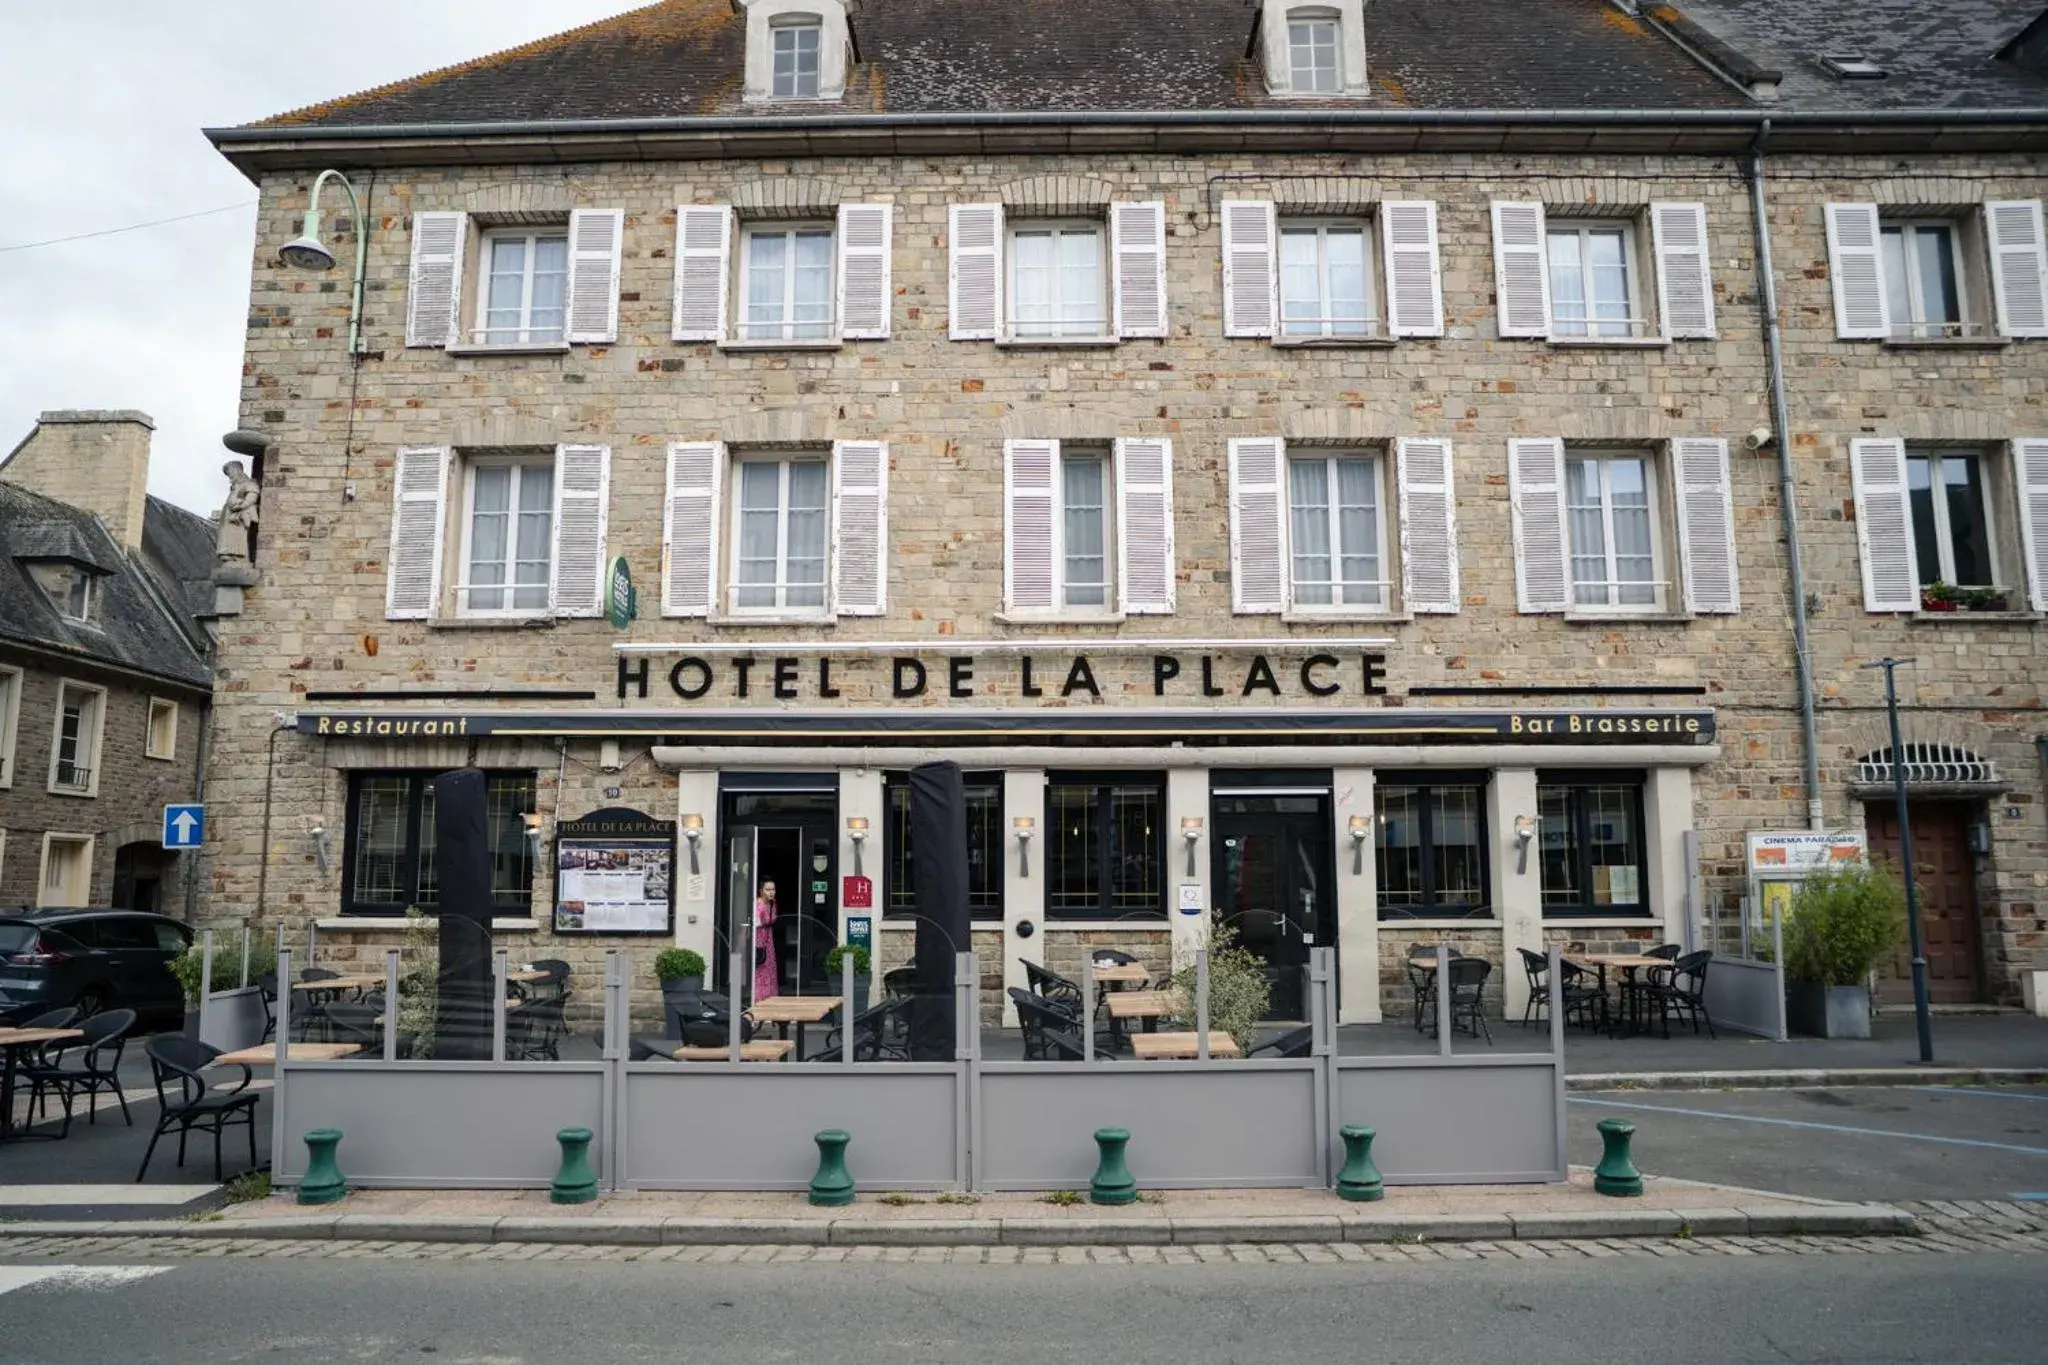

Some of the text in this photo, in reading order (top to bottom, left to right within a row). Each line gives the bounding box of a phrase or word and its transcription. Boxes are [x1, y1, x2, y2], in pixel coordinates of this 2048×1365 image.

[618, 655, 1389, 698] HOTEL DE LA PLACE
[317, 715, 467, 735] Restaurant
[1510, 714, 1700, 733] Bar Brasserie
[562, 822, 670, 832] HOTEL DE LA PLACE
[1763, 837, 1803, 845] CINEMA
[857, 881, 868, 893] H
